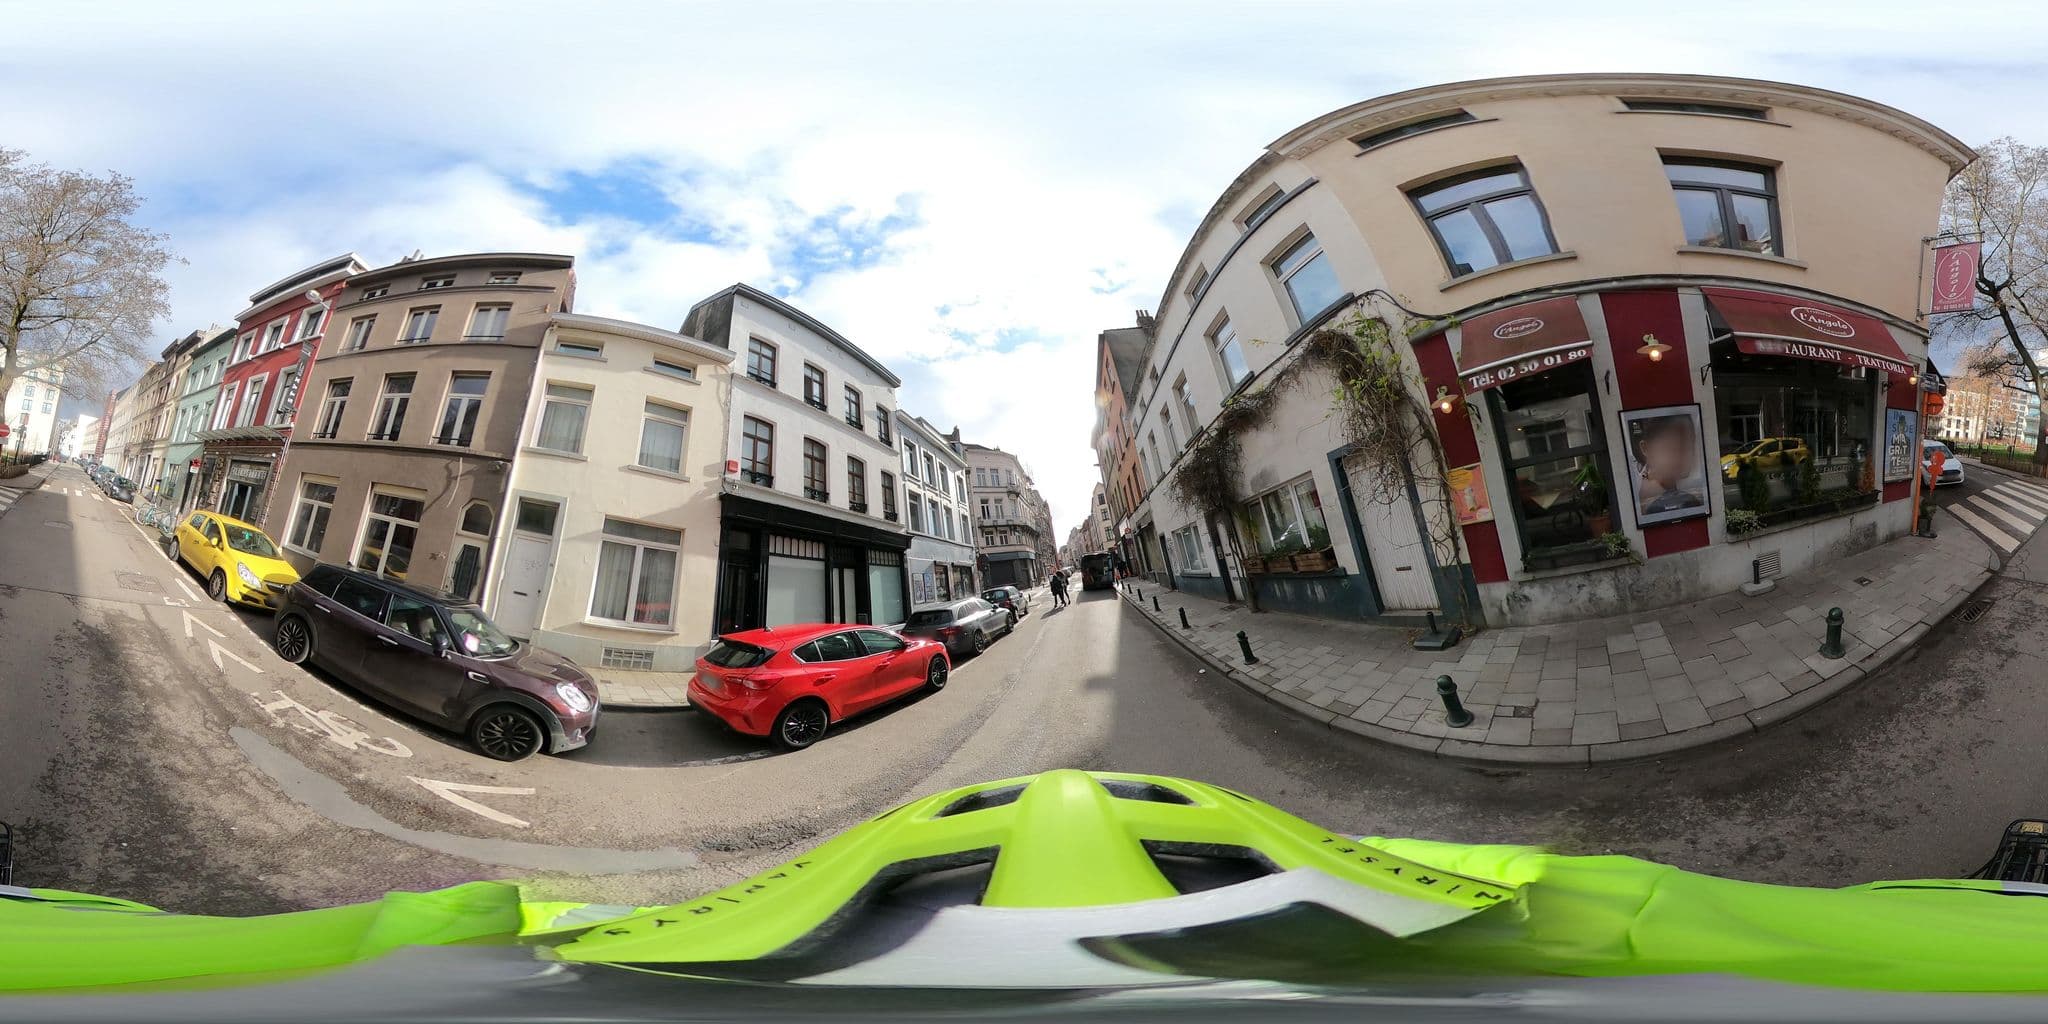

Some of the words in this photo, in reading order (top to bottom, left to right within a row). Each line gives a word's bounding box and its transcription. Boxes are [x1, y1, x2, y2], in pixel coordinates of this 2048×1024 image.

[1497, 366, 1516, 381] 02
[1544, 355, 1562, 366] 01
[1568, 349, 1587, 361] 80
[1855, 354, 1907, 375] TRATTORIA
[1893, 433, 1906, 444] MA
